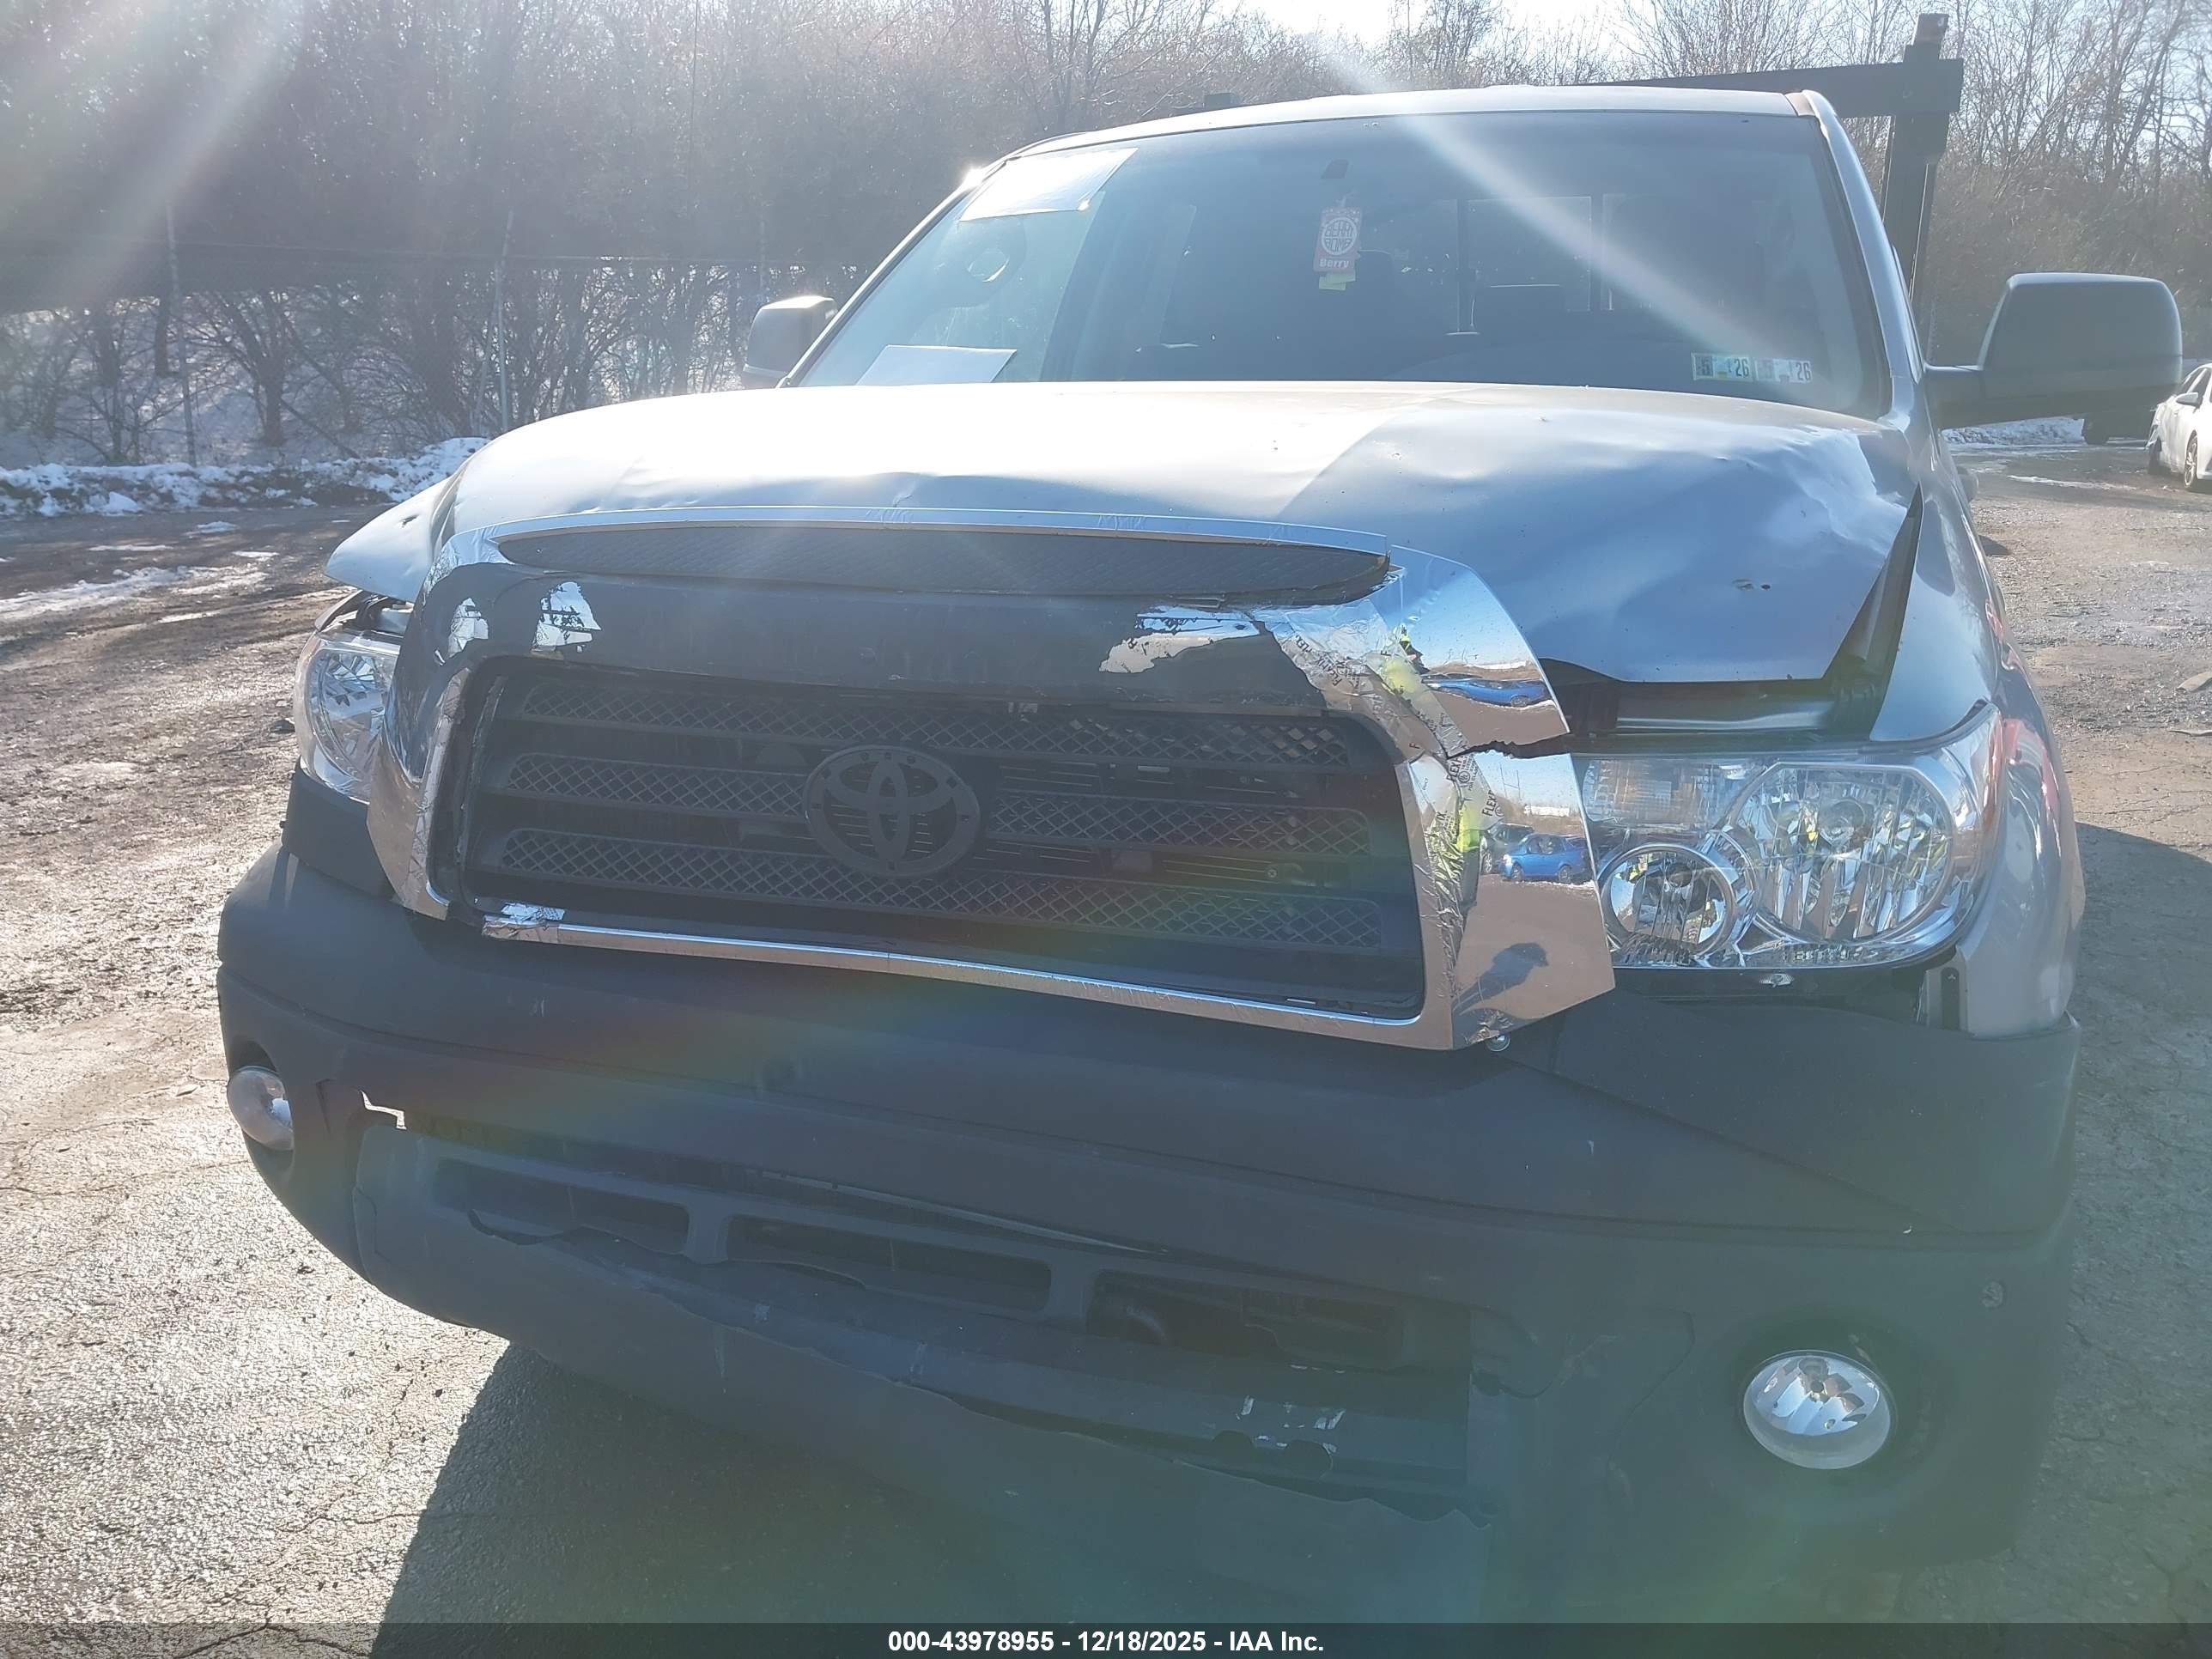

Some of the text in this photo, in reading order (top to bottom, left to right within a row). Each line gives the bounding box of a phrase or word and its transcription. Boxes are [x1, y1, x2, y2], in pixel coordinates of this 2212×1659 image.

[1320, 258, 1349, 269] Berry
[1734, 358, 1749, 377] 26
[1796, 362, 1812, 381] 26
